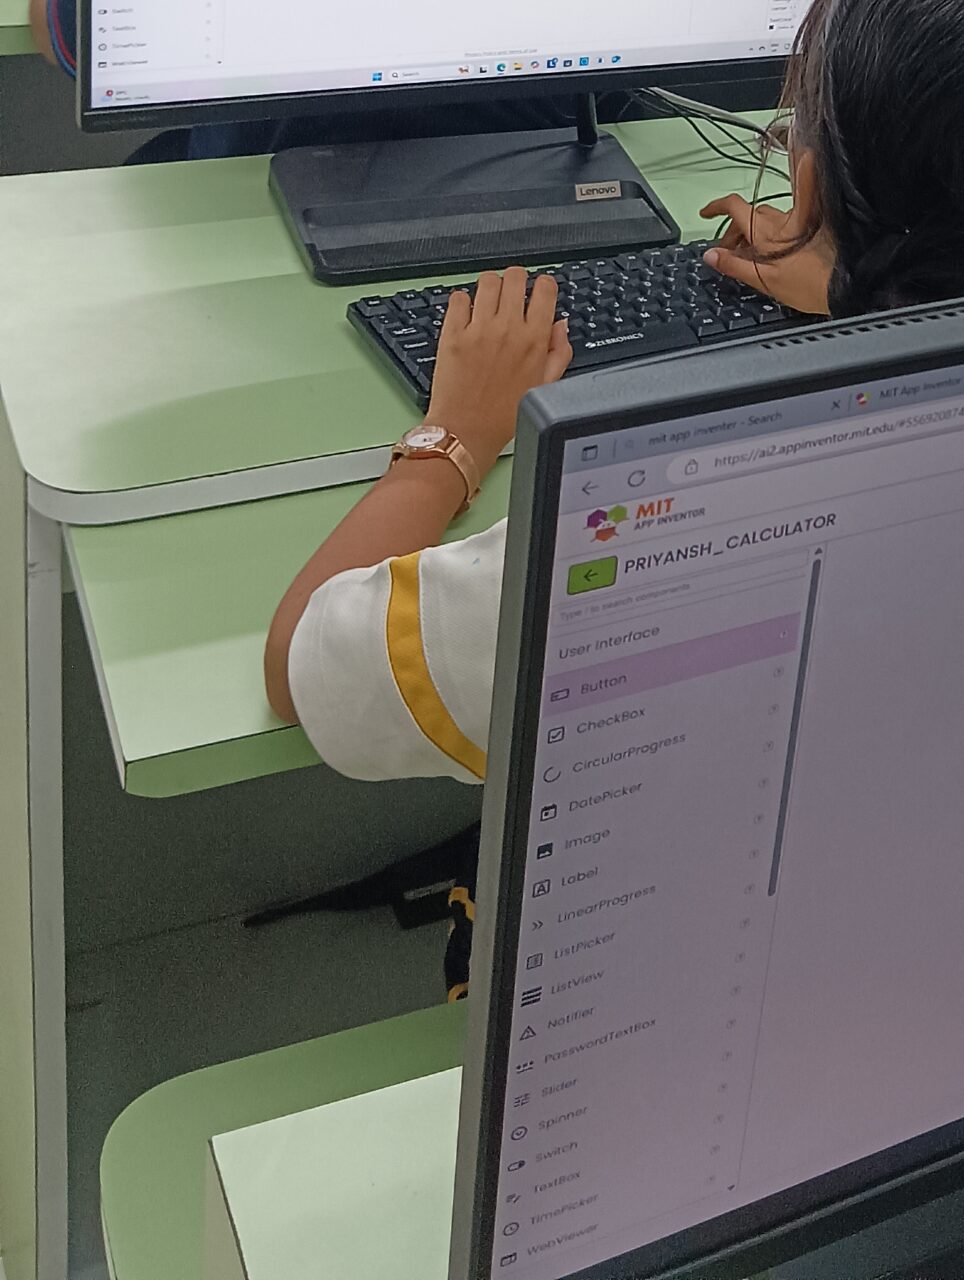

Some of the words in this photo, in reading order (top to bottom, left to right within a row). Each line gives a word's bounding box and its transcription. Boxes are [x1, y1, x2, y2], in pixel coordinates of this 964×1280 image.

[579, 184, 618, 197] Lenovo
[595, 332, 645, 348] ZEBRONICS
[880, 387, 898, 399] MIT
[900, 383, 920, 398] App
[669, 431, 691, 444] app
[747, 411, 783, 427] Search
[634, 519, 655, 531] APP
[657, 506, 706, 526] INVENTOR
[635, 497, 675, 520] MIT
[624, 513, 837, 573] PRIYANSH_CALCULATOR
[558, 642, 591, 660] User
[595, 625, 660, 651] Interface
[580, 674, 628, 696] Button
[576, 706, 646, 735] CheckBox
[572, 732, 687, 774] CircularProgress
[568, 781, 643, 813] DatePicker
[564, 827, 611, 851] Image
[560, 866, 599, 888] Label
[557, 885, 657, 924] LinearProgress
[554, 930, 616, 960] ListPicker
[550, 970, 605, 995] ListView
[546, 1005, 597, 1030] Notifier
[543, 1018, 657, 1065] PasswordTextBox
[541, 1077, 578, 1098] Slider
[537, 1104, 589, 1132] Spinner
[534, 1139, 579, 1164] Switch
[532, 1169, 581, 1195] TextBox
[529, 1192, 600, 1225] TimePicker
[526, 1222, 600, 1257] WebViewer
